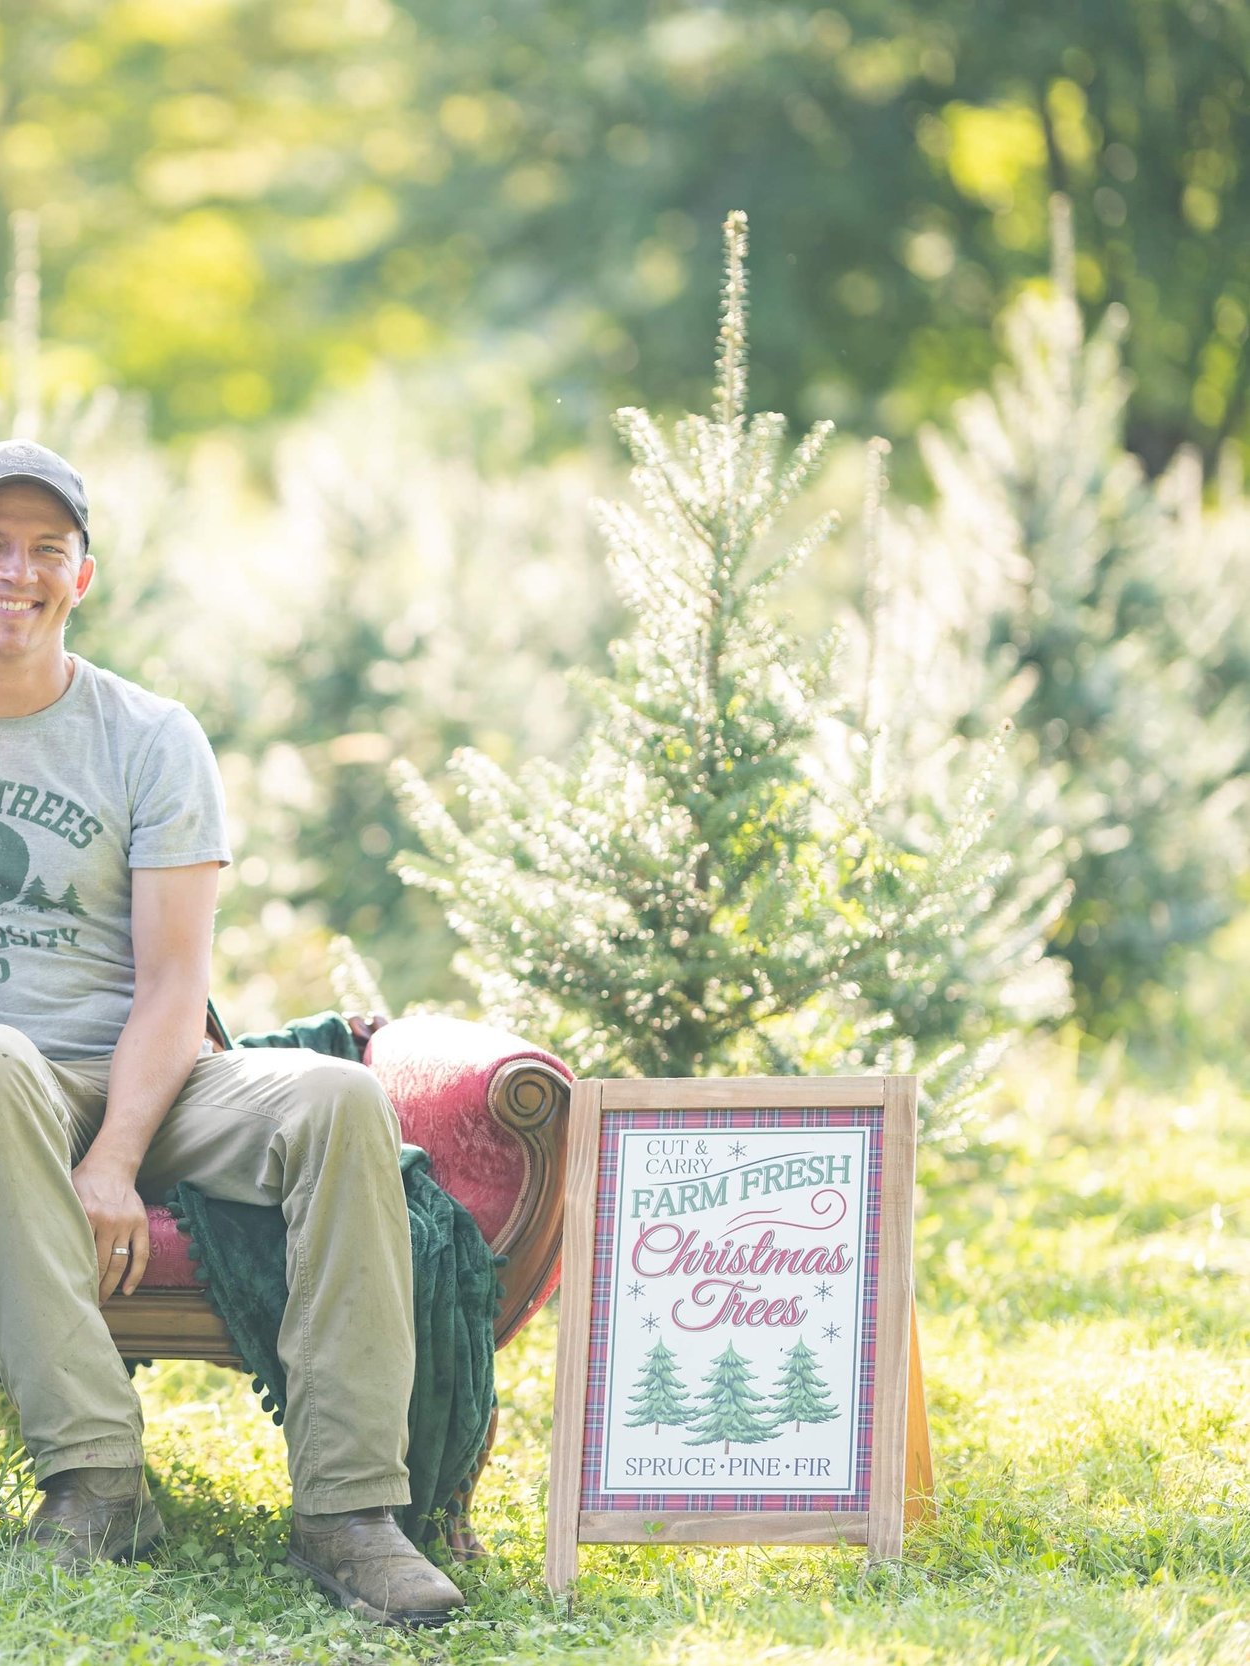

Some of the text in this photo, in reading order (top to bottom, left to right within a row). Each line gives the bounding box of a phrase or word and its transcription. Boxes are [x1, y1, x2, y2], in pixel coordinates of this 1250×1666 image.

[646, 1139, 709, 1156] CUT &
[645, 1158, 713, 1174] CARRY
[630, 1155, 851, 1219] FARM FRESH
[631, 1222, 853, 1278] Christmas
[671, 1279, 808, 1332] Trees
[625, 1457, 831, 1477] SPRUCE PINE FIR
